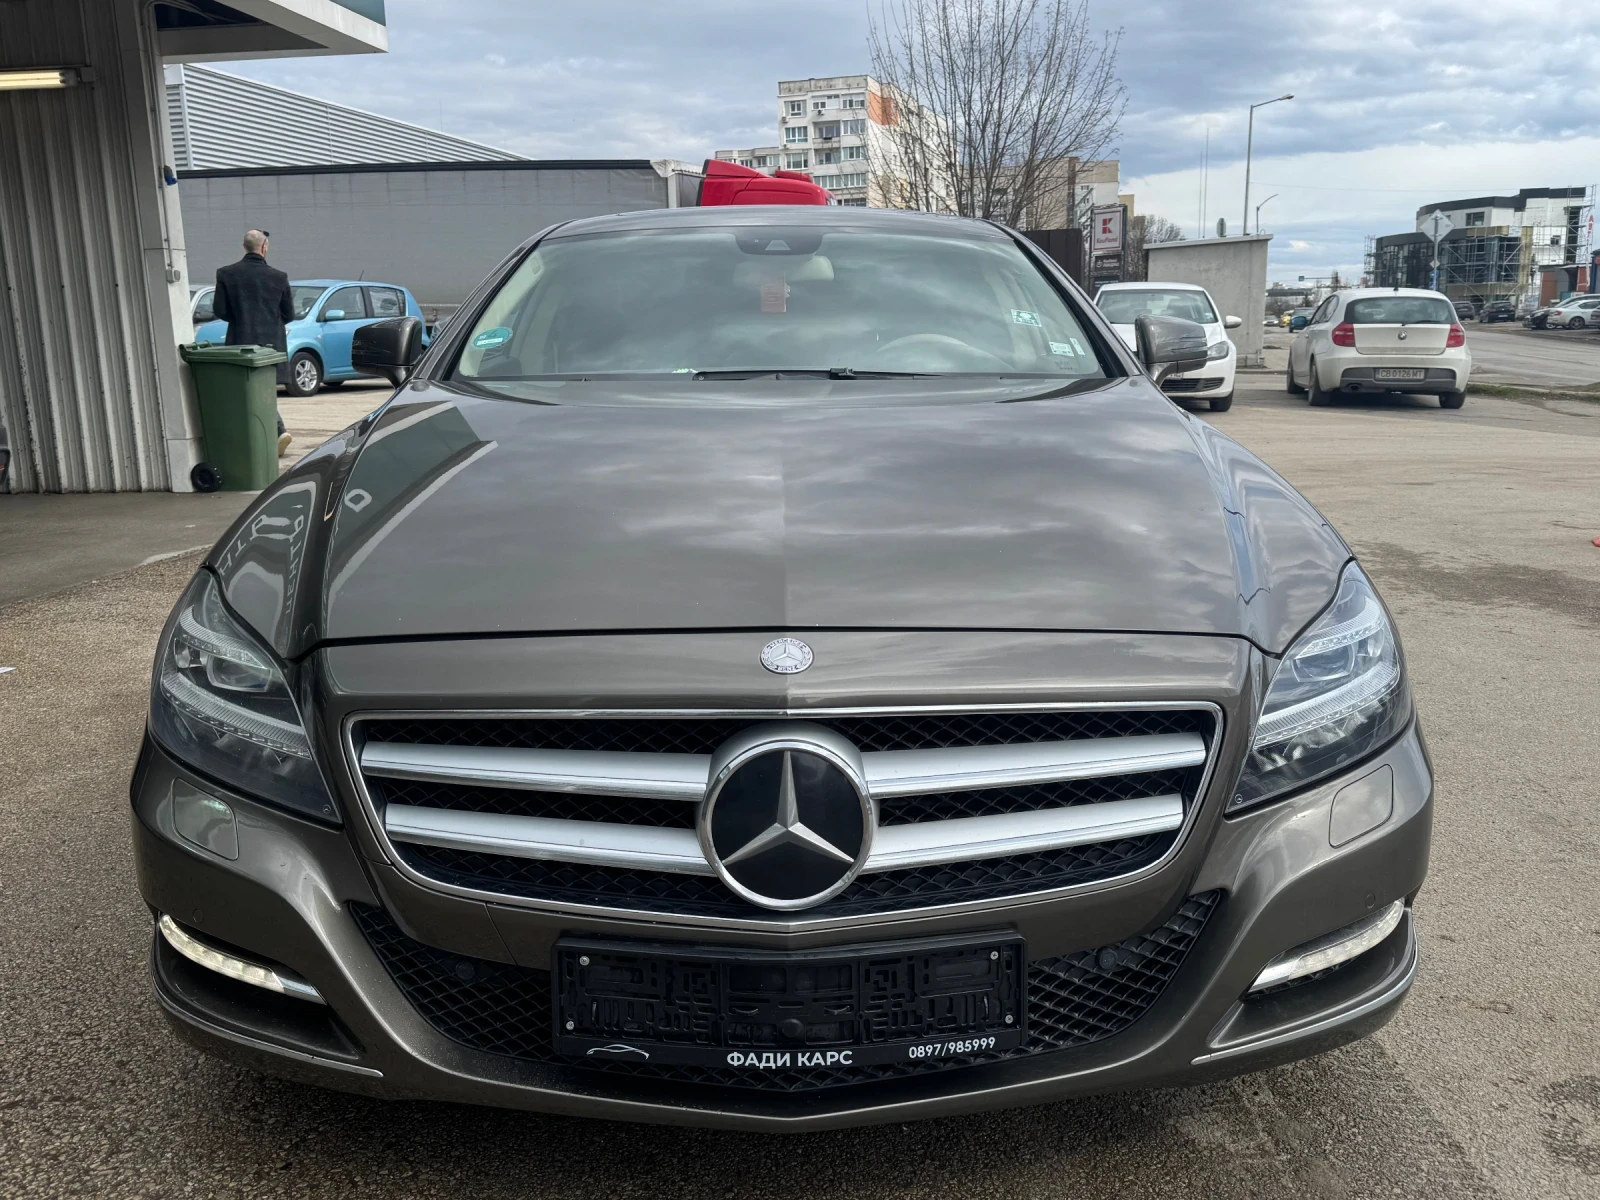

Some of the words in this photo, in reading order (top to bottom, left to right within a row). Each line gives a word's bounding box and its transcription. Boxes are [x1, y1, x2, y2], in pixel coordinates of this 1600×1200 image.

[908, 1036, 996, 1058] 0897/985999
[726, 1051, 791, 1069] ФАДИ
[797, 1050, 853, 1067] КАРС
